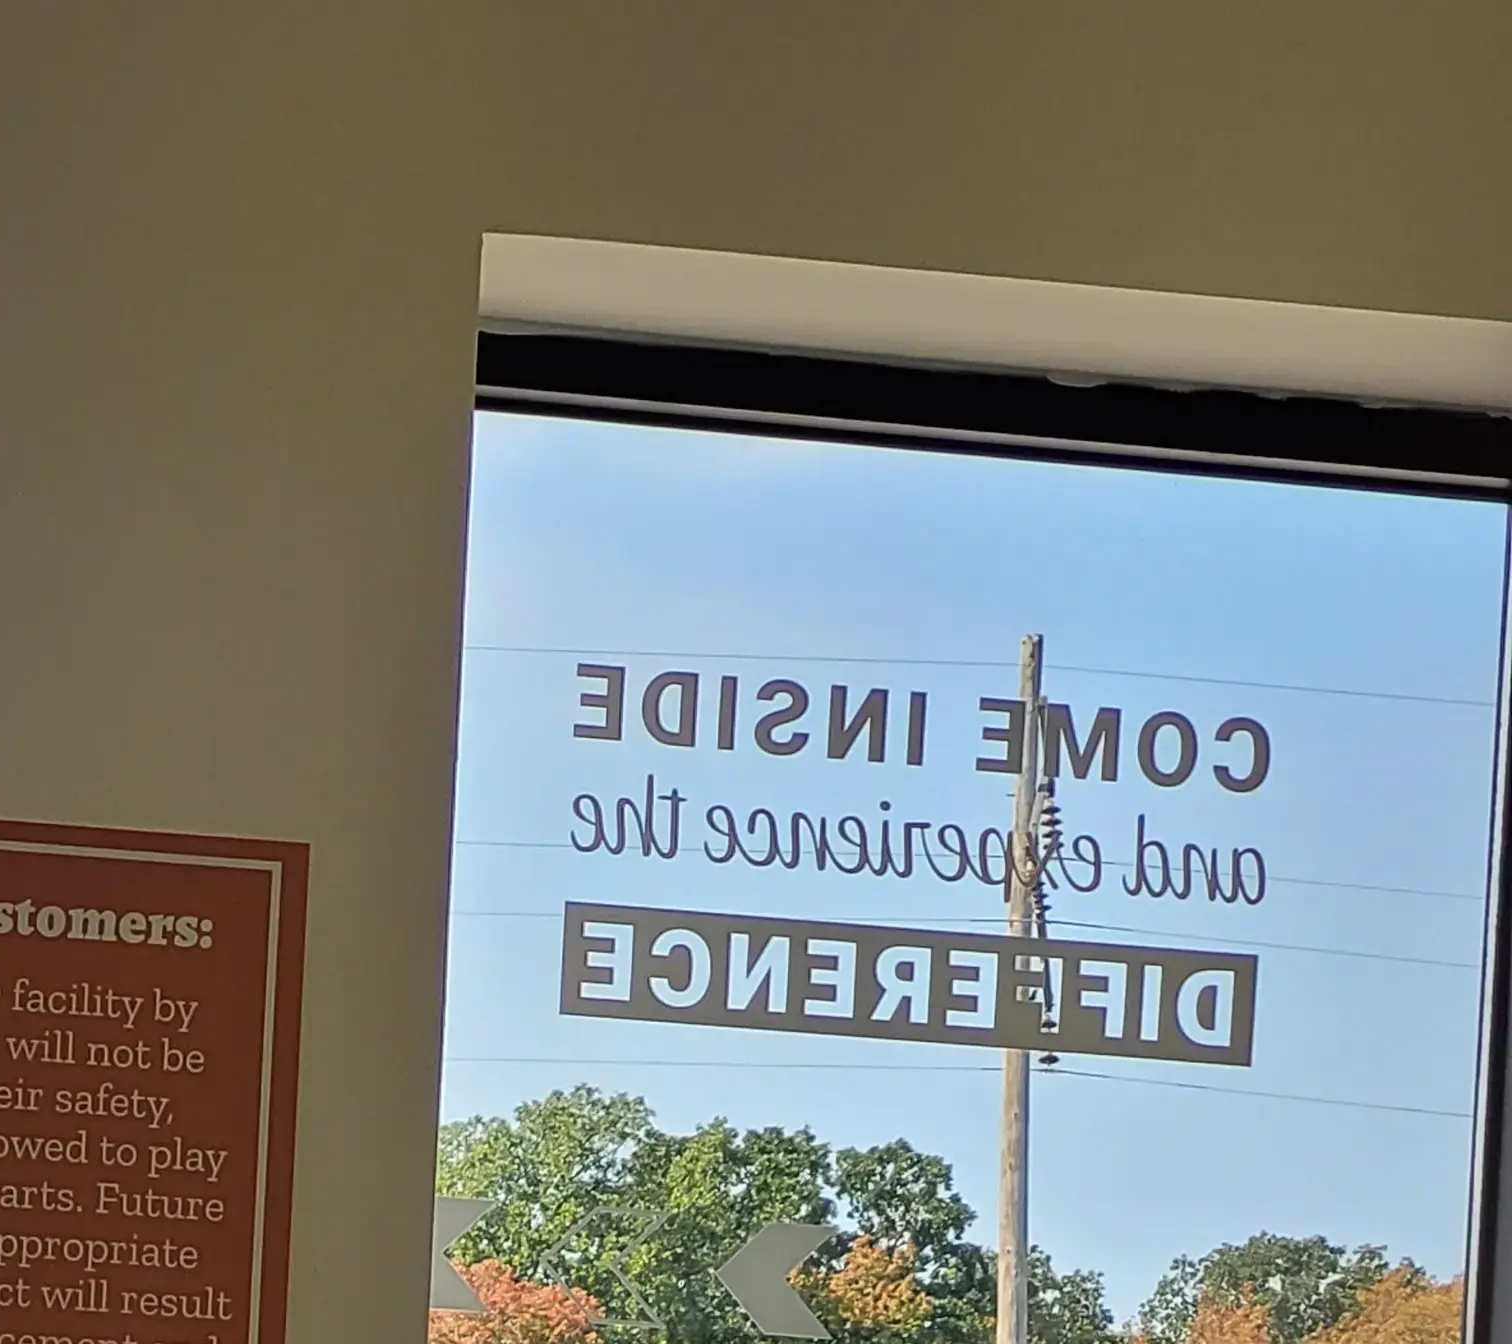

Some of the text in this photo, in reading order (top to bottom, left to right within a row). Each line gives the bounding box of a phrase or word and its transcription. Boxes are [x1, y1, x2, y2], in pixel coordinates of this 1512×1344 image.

[12, 978, 144, 1028] facility
[154, 988, 198, 1032] by
[6, 1030, 75, 1063] will
[87, 1041, 151, 1068] not
[162, 1038, 204, 1072] be
[56, 1083, 172, 1128] safety,
[100, 1137, 136, 1166] to
[148, 1137, 228, 1181] play
[96, 1183, 223, 1221] Future
[41, 1279, 109, 1312] will
[121, 1287, 232, 1320] result
